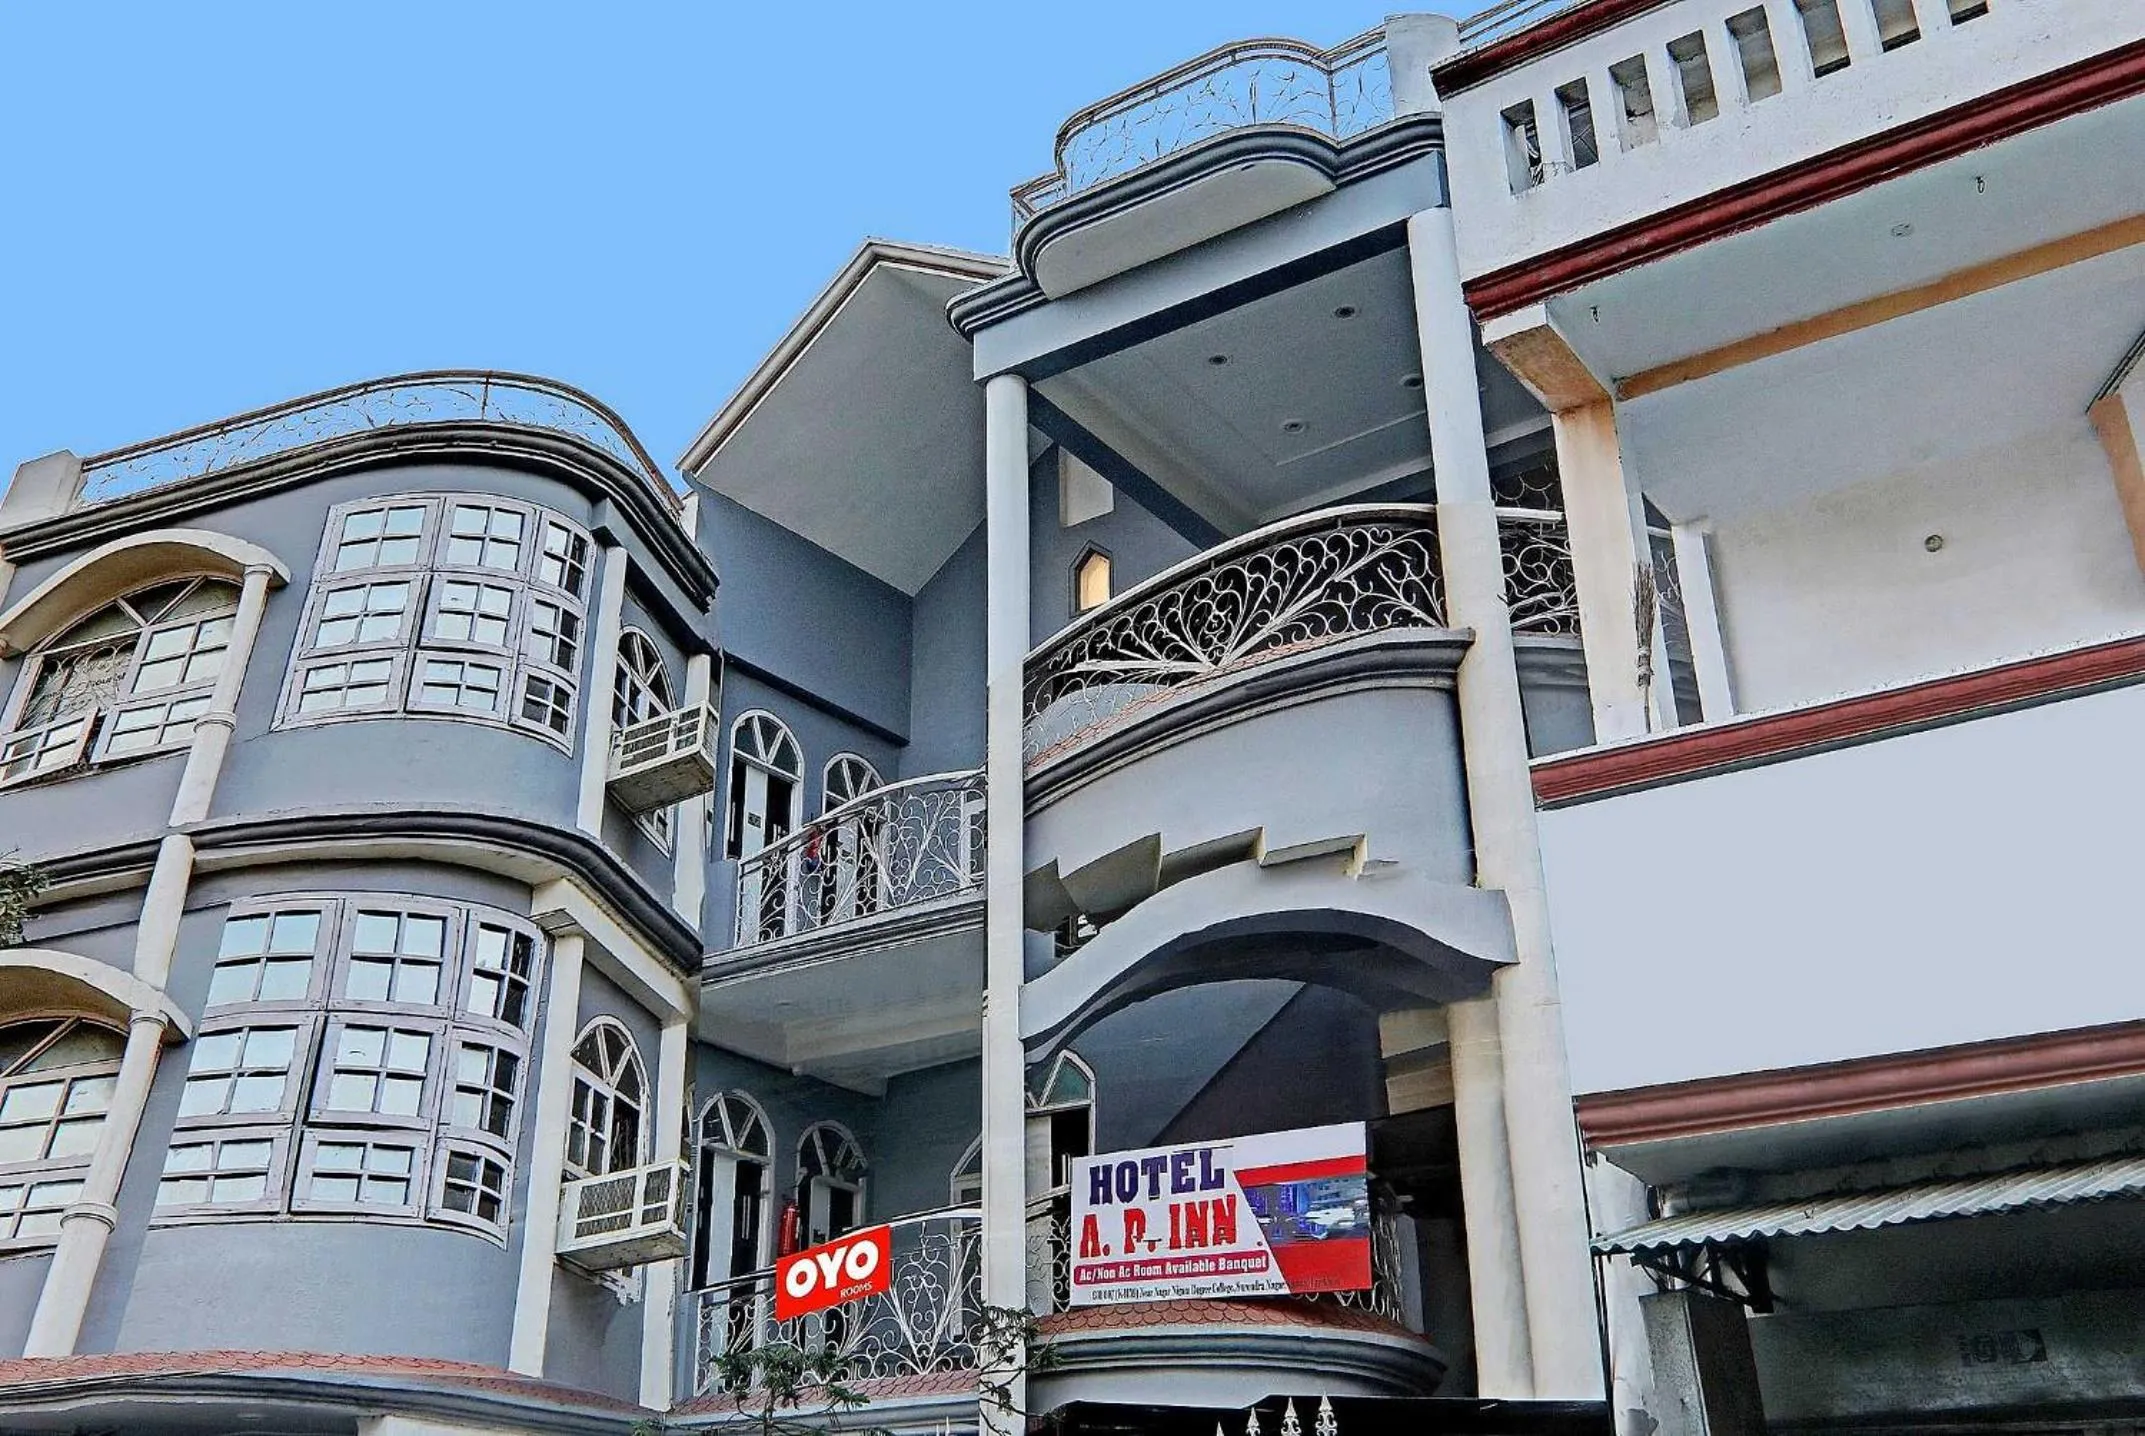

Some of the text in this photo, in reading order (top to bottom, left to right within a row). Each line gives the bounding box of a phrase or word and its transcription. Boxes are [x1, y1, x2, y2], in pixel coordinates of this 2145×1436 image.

[1090, 1148, 1225, 1205] HOTEL
[1168, 1194, 1237, 1250] INN
[785, 1239, 879, 1298] OYO
[840, 1281, 873, 1298] ROOMS
[1118, 1265, 1131, 1278] Ac
[1133, 1263, 1162, 1277] Room
[1165, 1257, 1216, 1275] Available
[1217, 1255, 1267, 1273] Banquet
